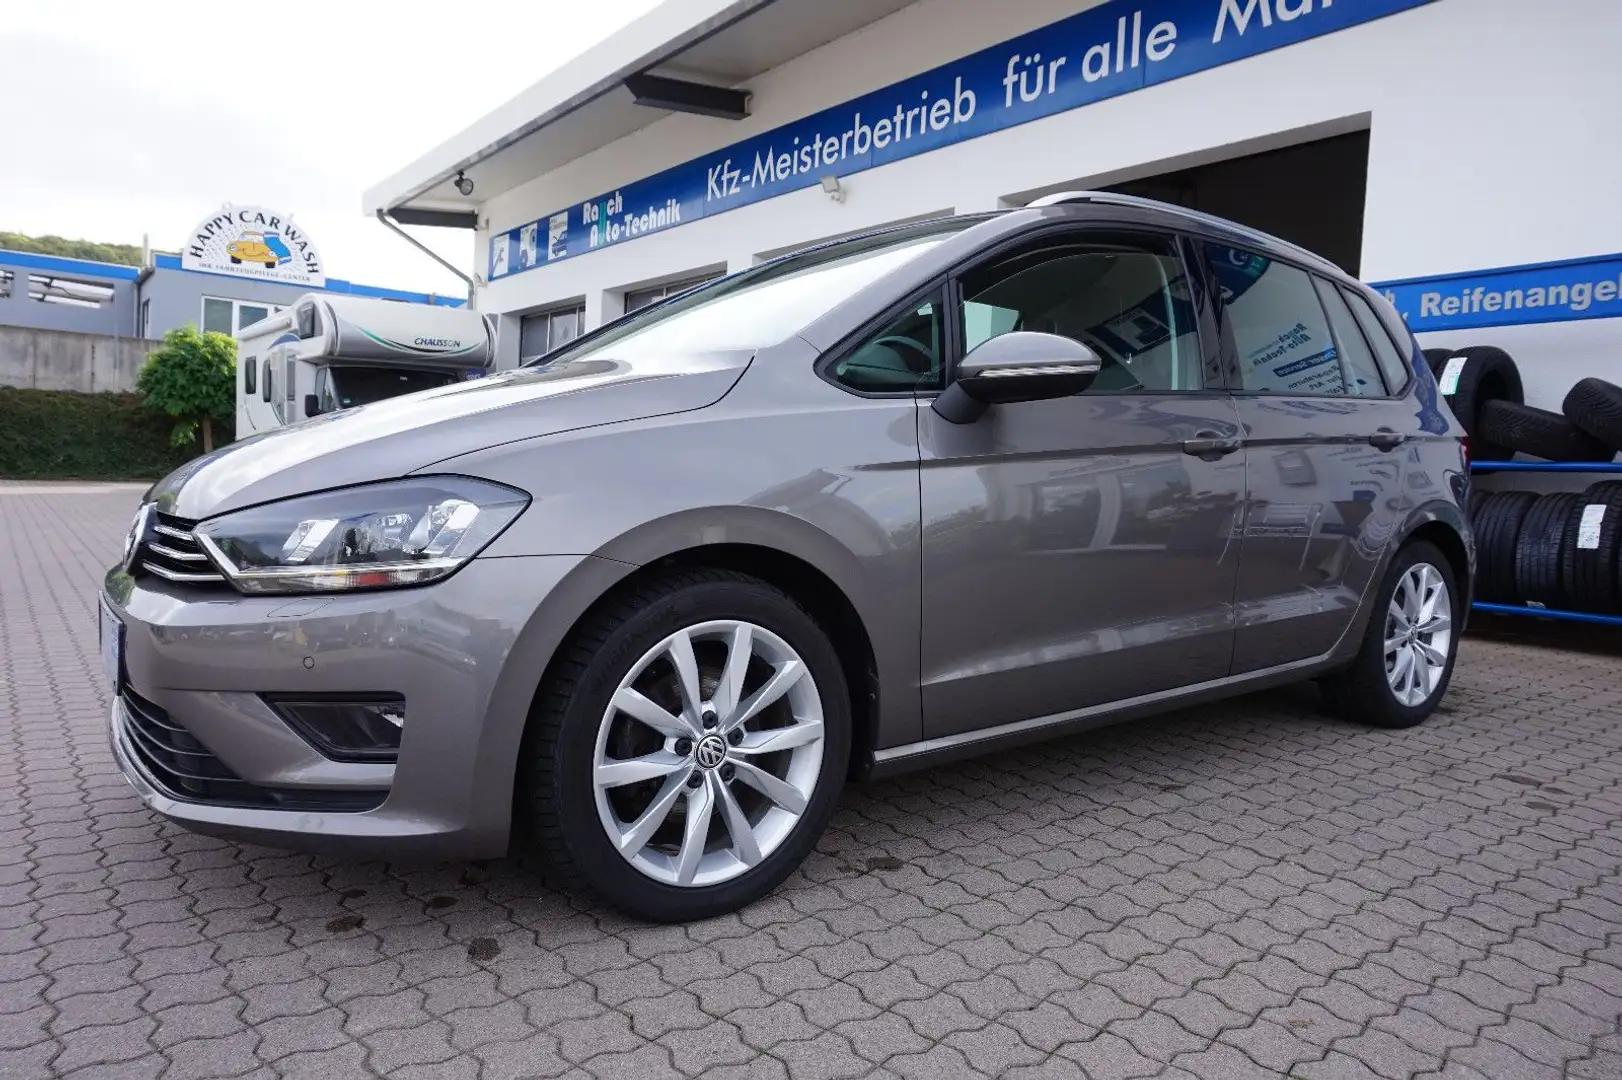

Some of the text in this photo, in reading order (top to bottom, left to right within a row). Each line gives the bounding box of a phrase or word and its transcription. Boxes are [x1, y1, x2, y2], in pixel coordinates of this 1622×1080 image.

[706, 76, 977, 202] Kfz-Meisterbetrieb
[1002, 53, 1067, 108] für
[1081, 10, 1178, 83] alle
[189, 210, 319, 274] HAPPY CAR WASH
[589, 198, 681, 248] Auto-Technik
[1420, 270, 1622, 318] Reifenange
[414, 337, 461, 348] CHAUSSON
